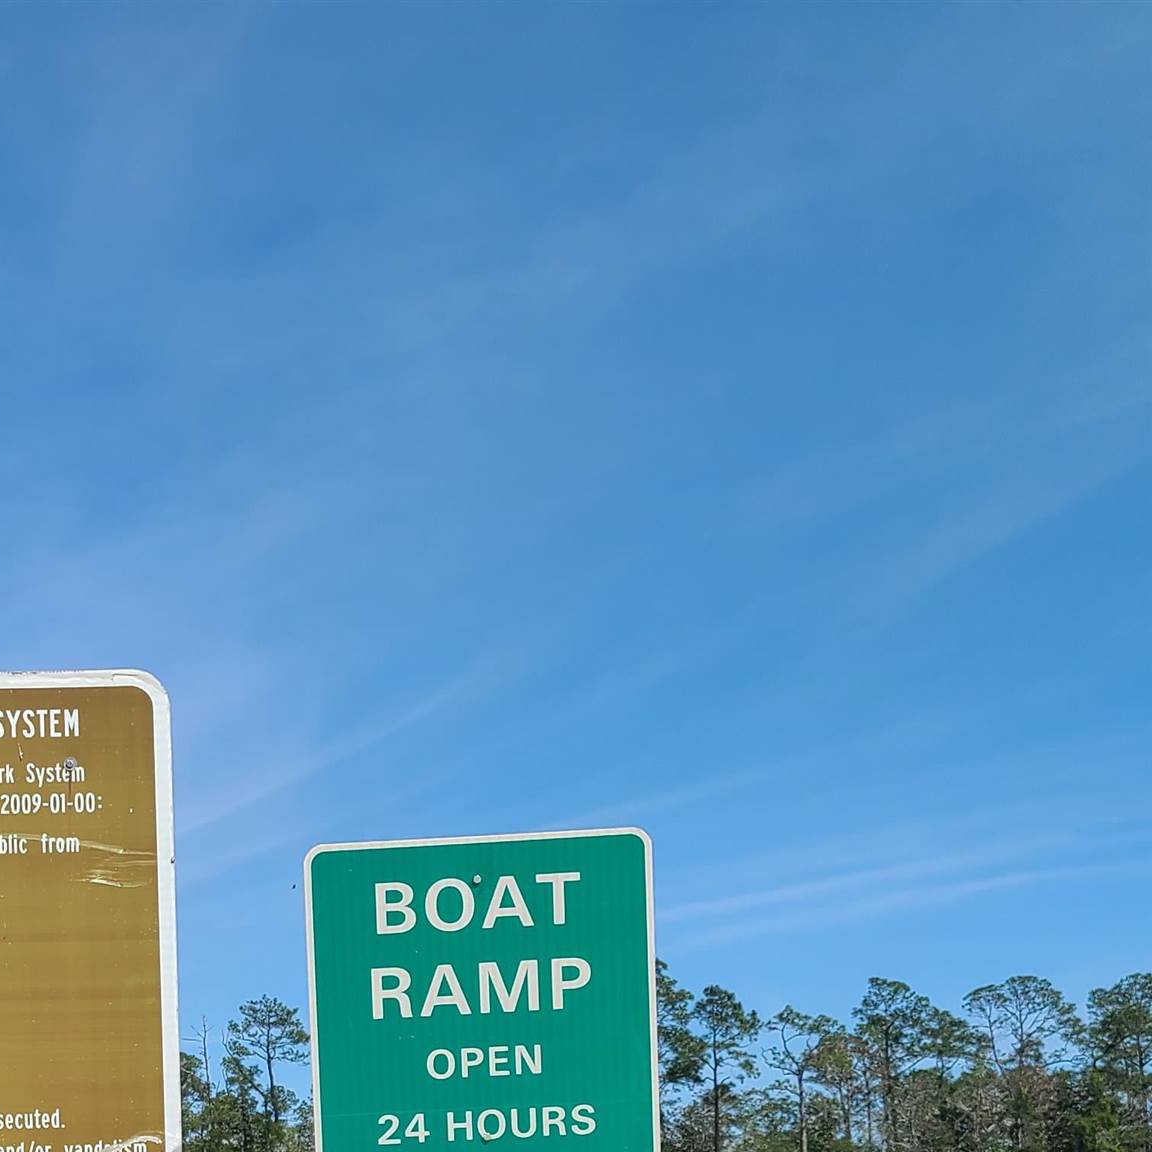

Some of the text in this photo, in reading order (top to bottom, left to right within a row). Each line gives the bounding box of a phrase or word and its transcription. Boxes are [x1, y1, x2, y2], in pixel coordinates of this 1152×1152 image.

[25, 762, 85, 788] System
[0, 792, 103, 815] 2009-01-00:
[40, 833, 81, 854] from
[374, 872, 581, 935] BOAT
[370, 957, 592, 1020] RAMP
[426, 1044, 542, 1080] OPEN
[377, 1104, 597, 1145] 24 HOURS
